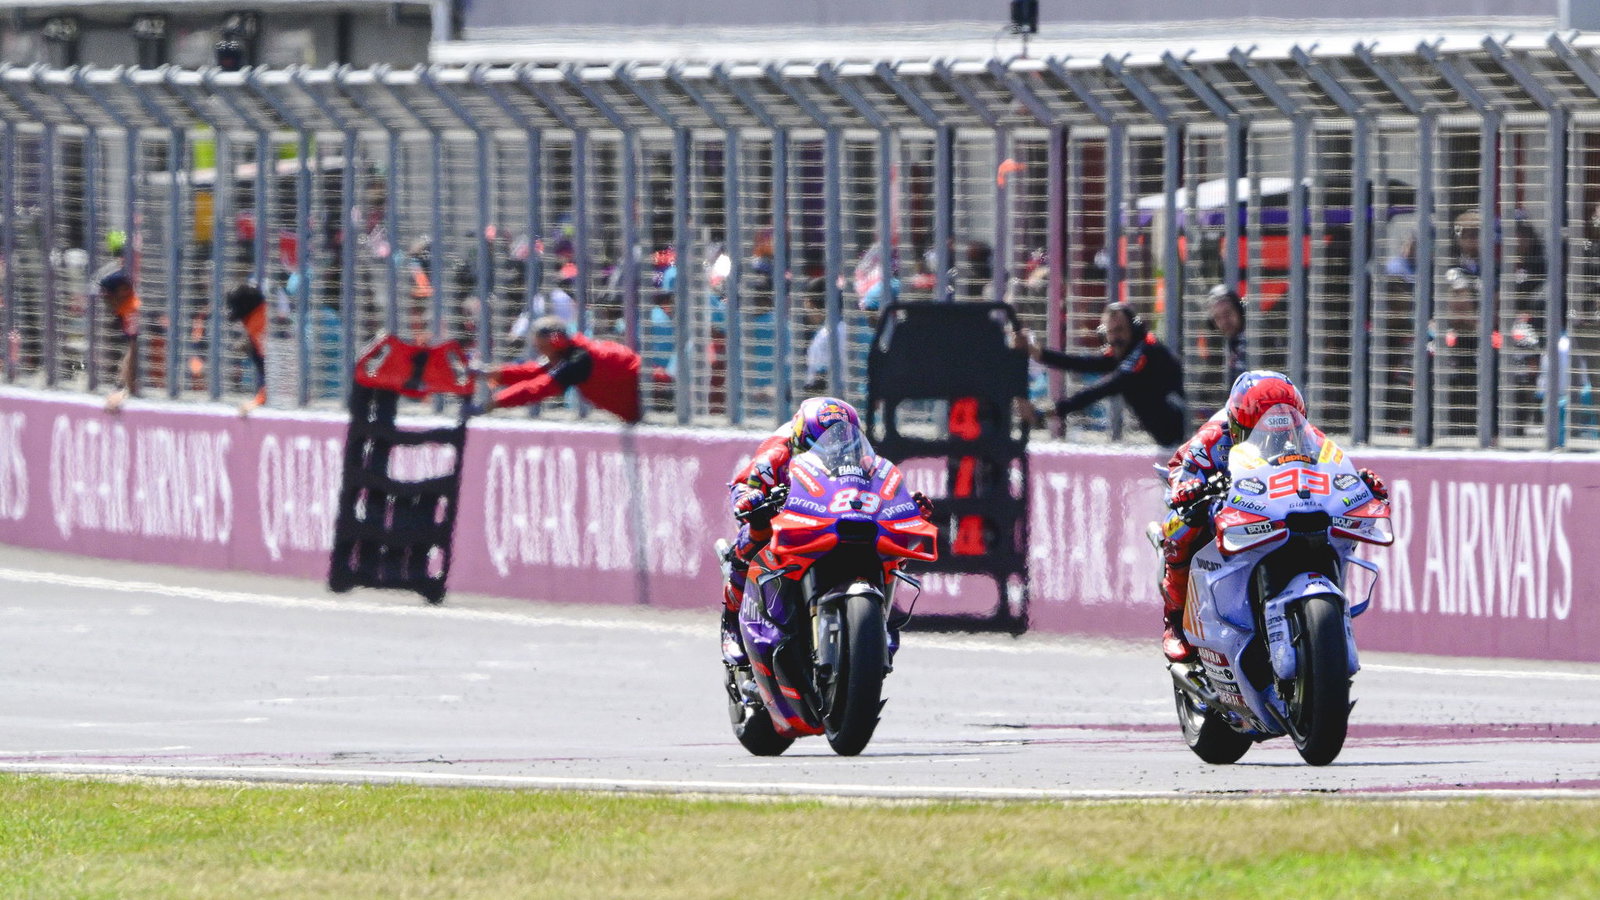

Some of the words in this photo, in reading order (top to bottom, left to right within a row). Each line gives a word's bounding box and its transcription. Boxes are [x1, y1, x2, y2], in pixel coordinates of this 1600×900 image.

[1268, 467, 1331, 500] 93
[788, 496, 827, 513] prima
[828, 487, 881, 514] 89
[882, 502, 916, 518] prima
[1421, 480, 1573, 620] AIRWAYS
